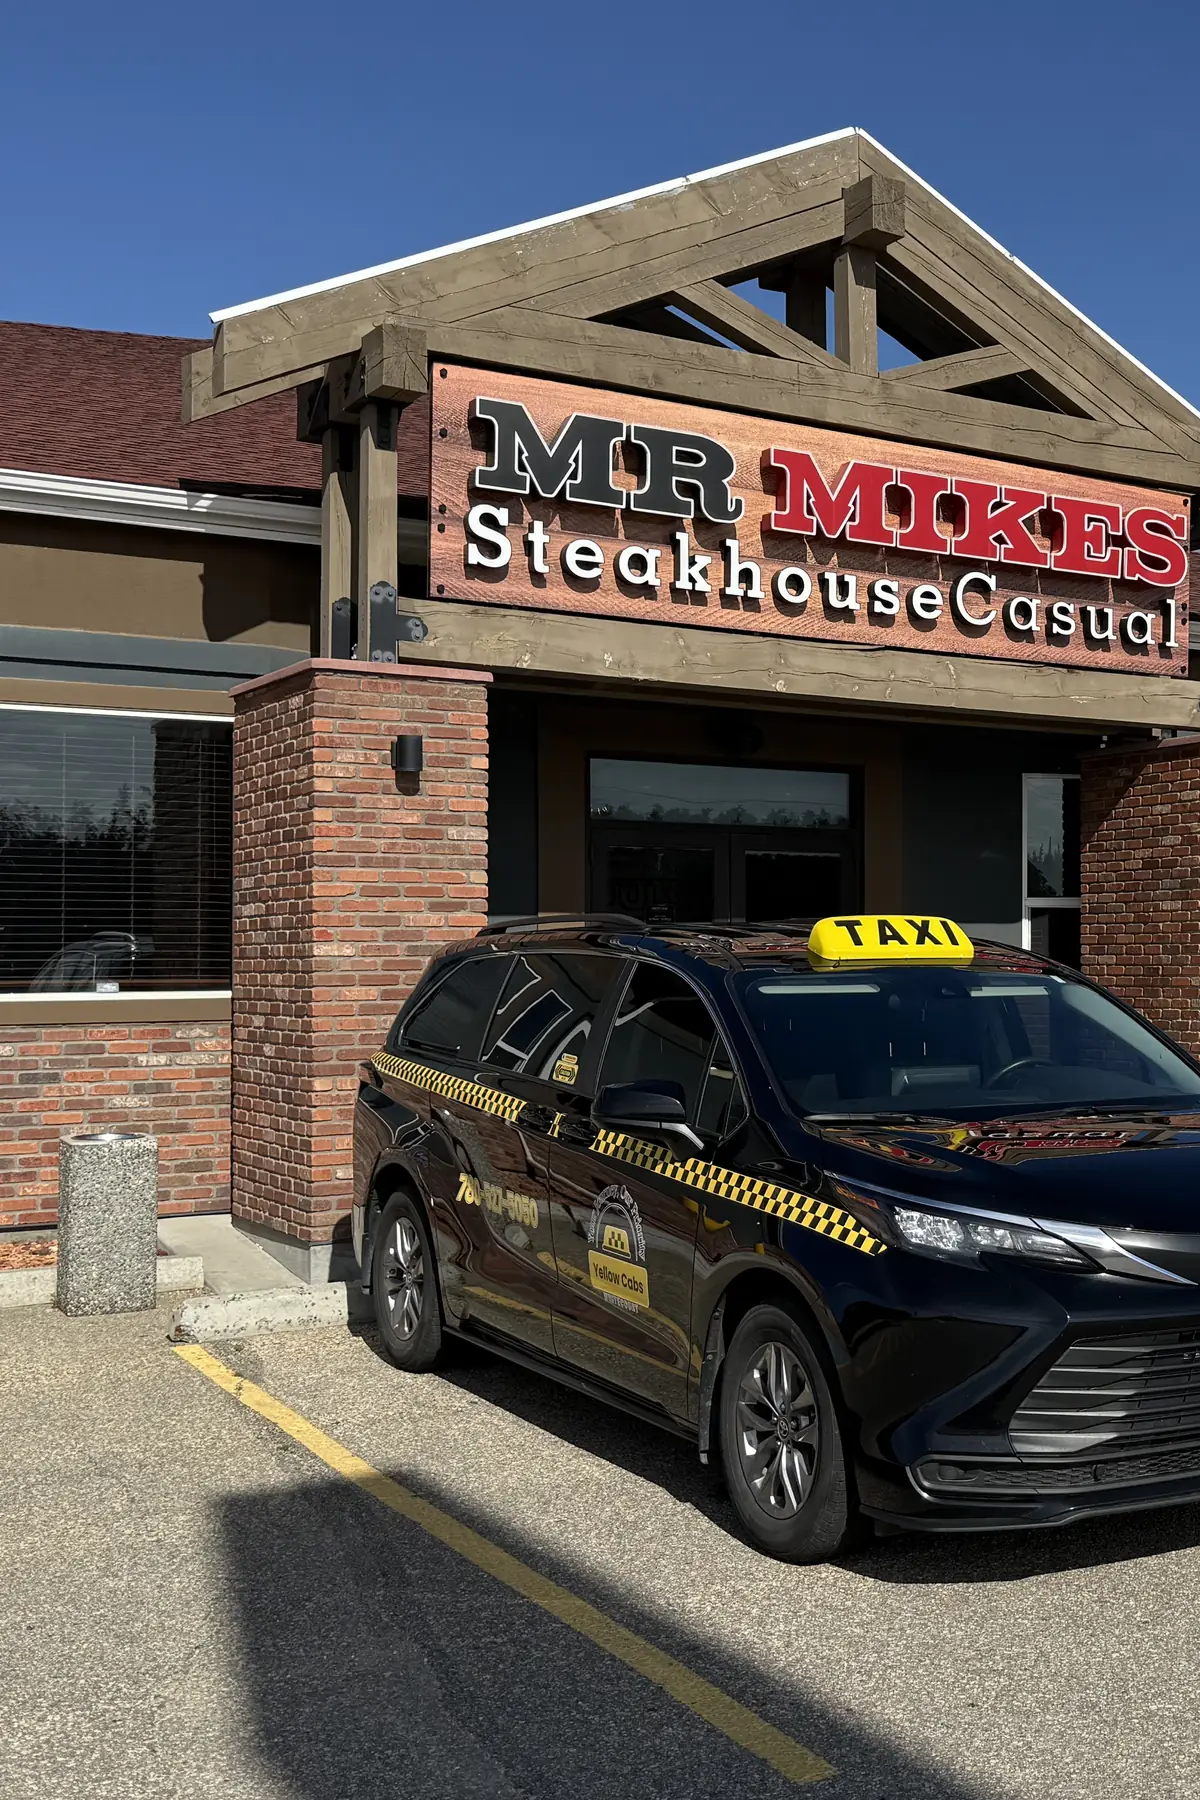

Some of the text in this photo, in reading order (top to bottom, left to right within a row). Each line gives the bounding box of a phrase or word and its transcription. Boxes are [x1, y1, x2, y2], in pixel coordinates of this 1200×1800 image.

[474, 395, 1189, 588] MR MIKES
[833, 918, 960, 947] TAXI
[593, 1262, 644, 1294] Yellow Cabs
